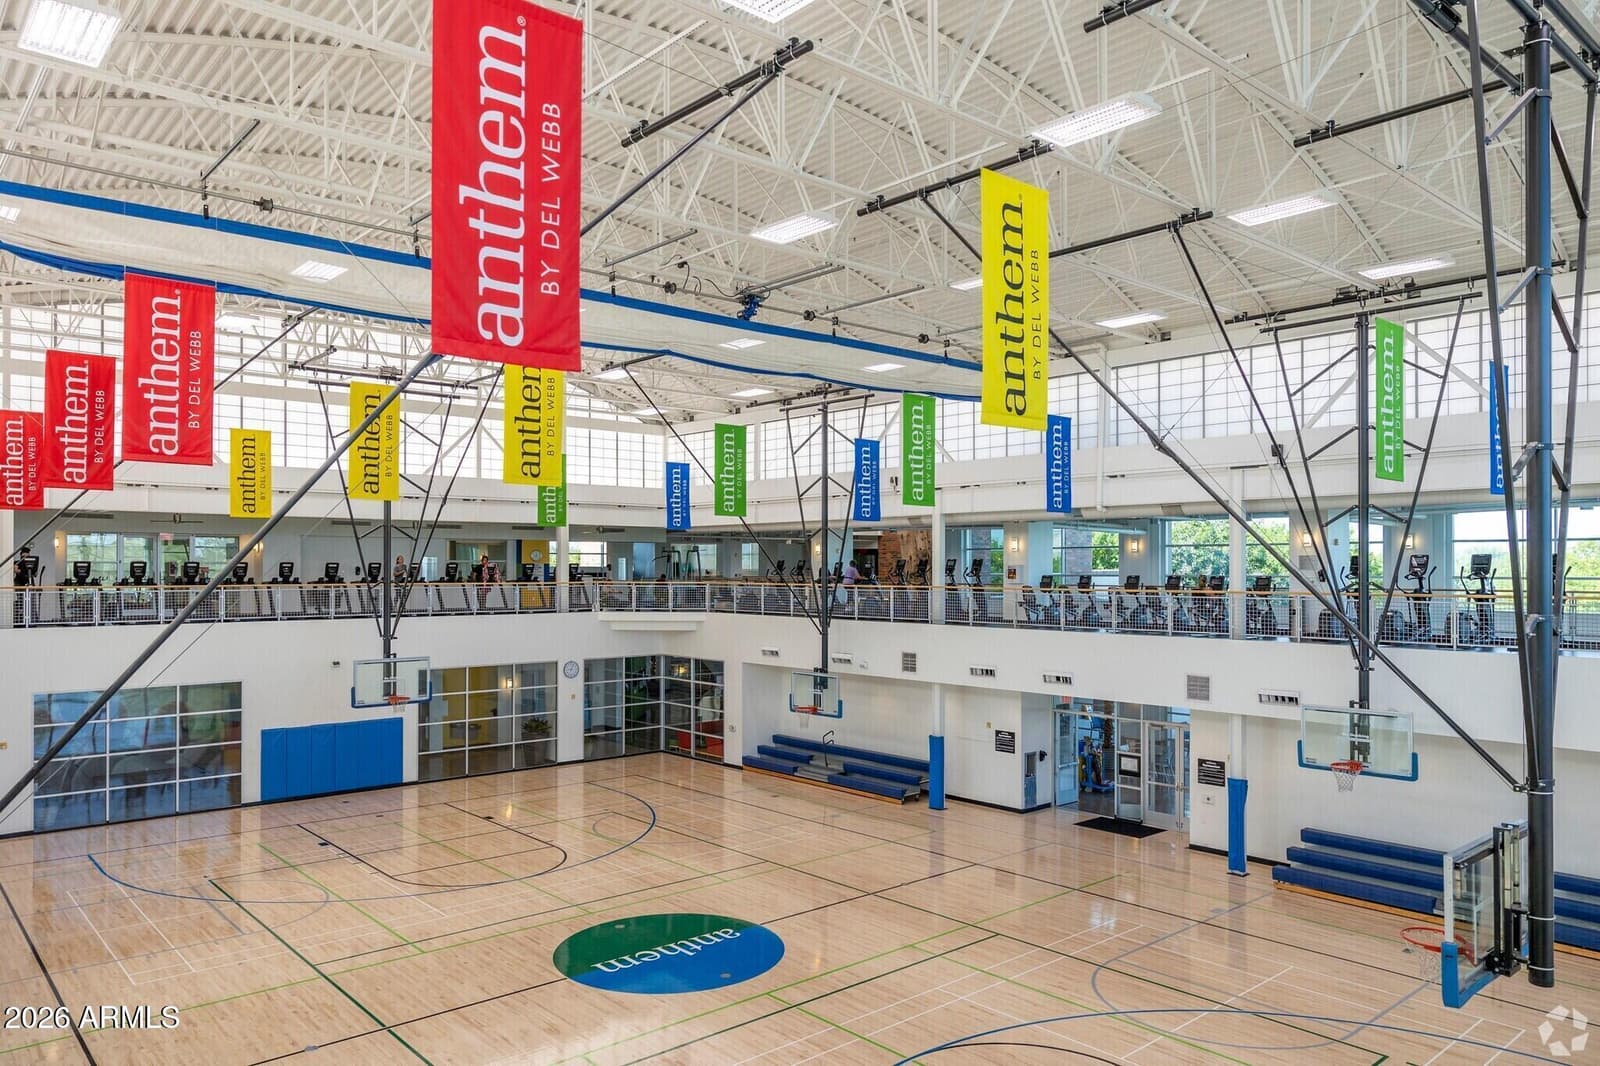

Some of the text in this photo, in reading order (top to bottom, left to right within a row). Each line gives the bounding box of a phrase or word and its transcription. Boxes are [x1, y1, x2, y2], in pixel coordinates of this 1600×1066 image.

[541, 103, 561, 296] BY DEL WEBB
[1031, 249, 1042, 379] BY DEL WEBB
[188, 331, 201, 429] BY DEL WEBB
[95, 390, 104, 463] BY DEL WEBB
[547, 442, 554, 456] BY
[28, 437, 36, 491] BY DEL WEBB
[385, 466, 392, 477] BY
[591, 928, 741, 973] anthem
